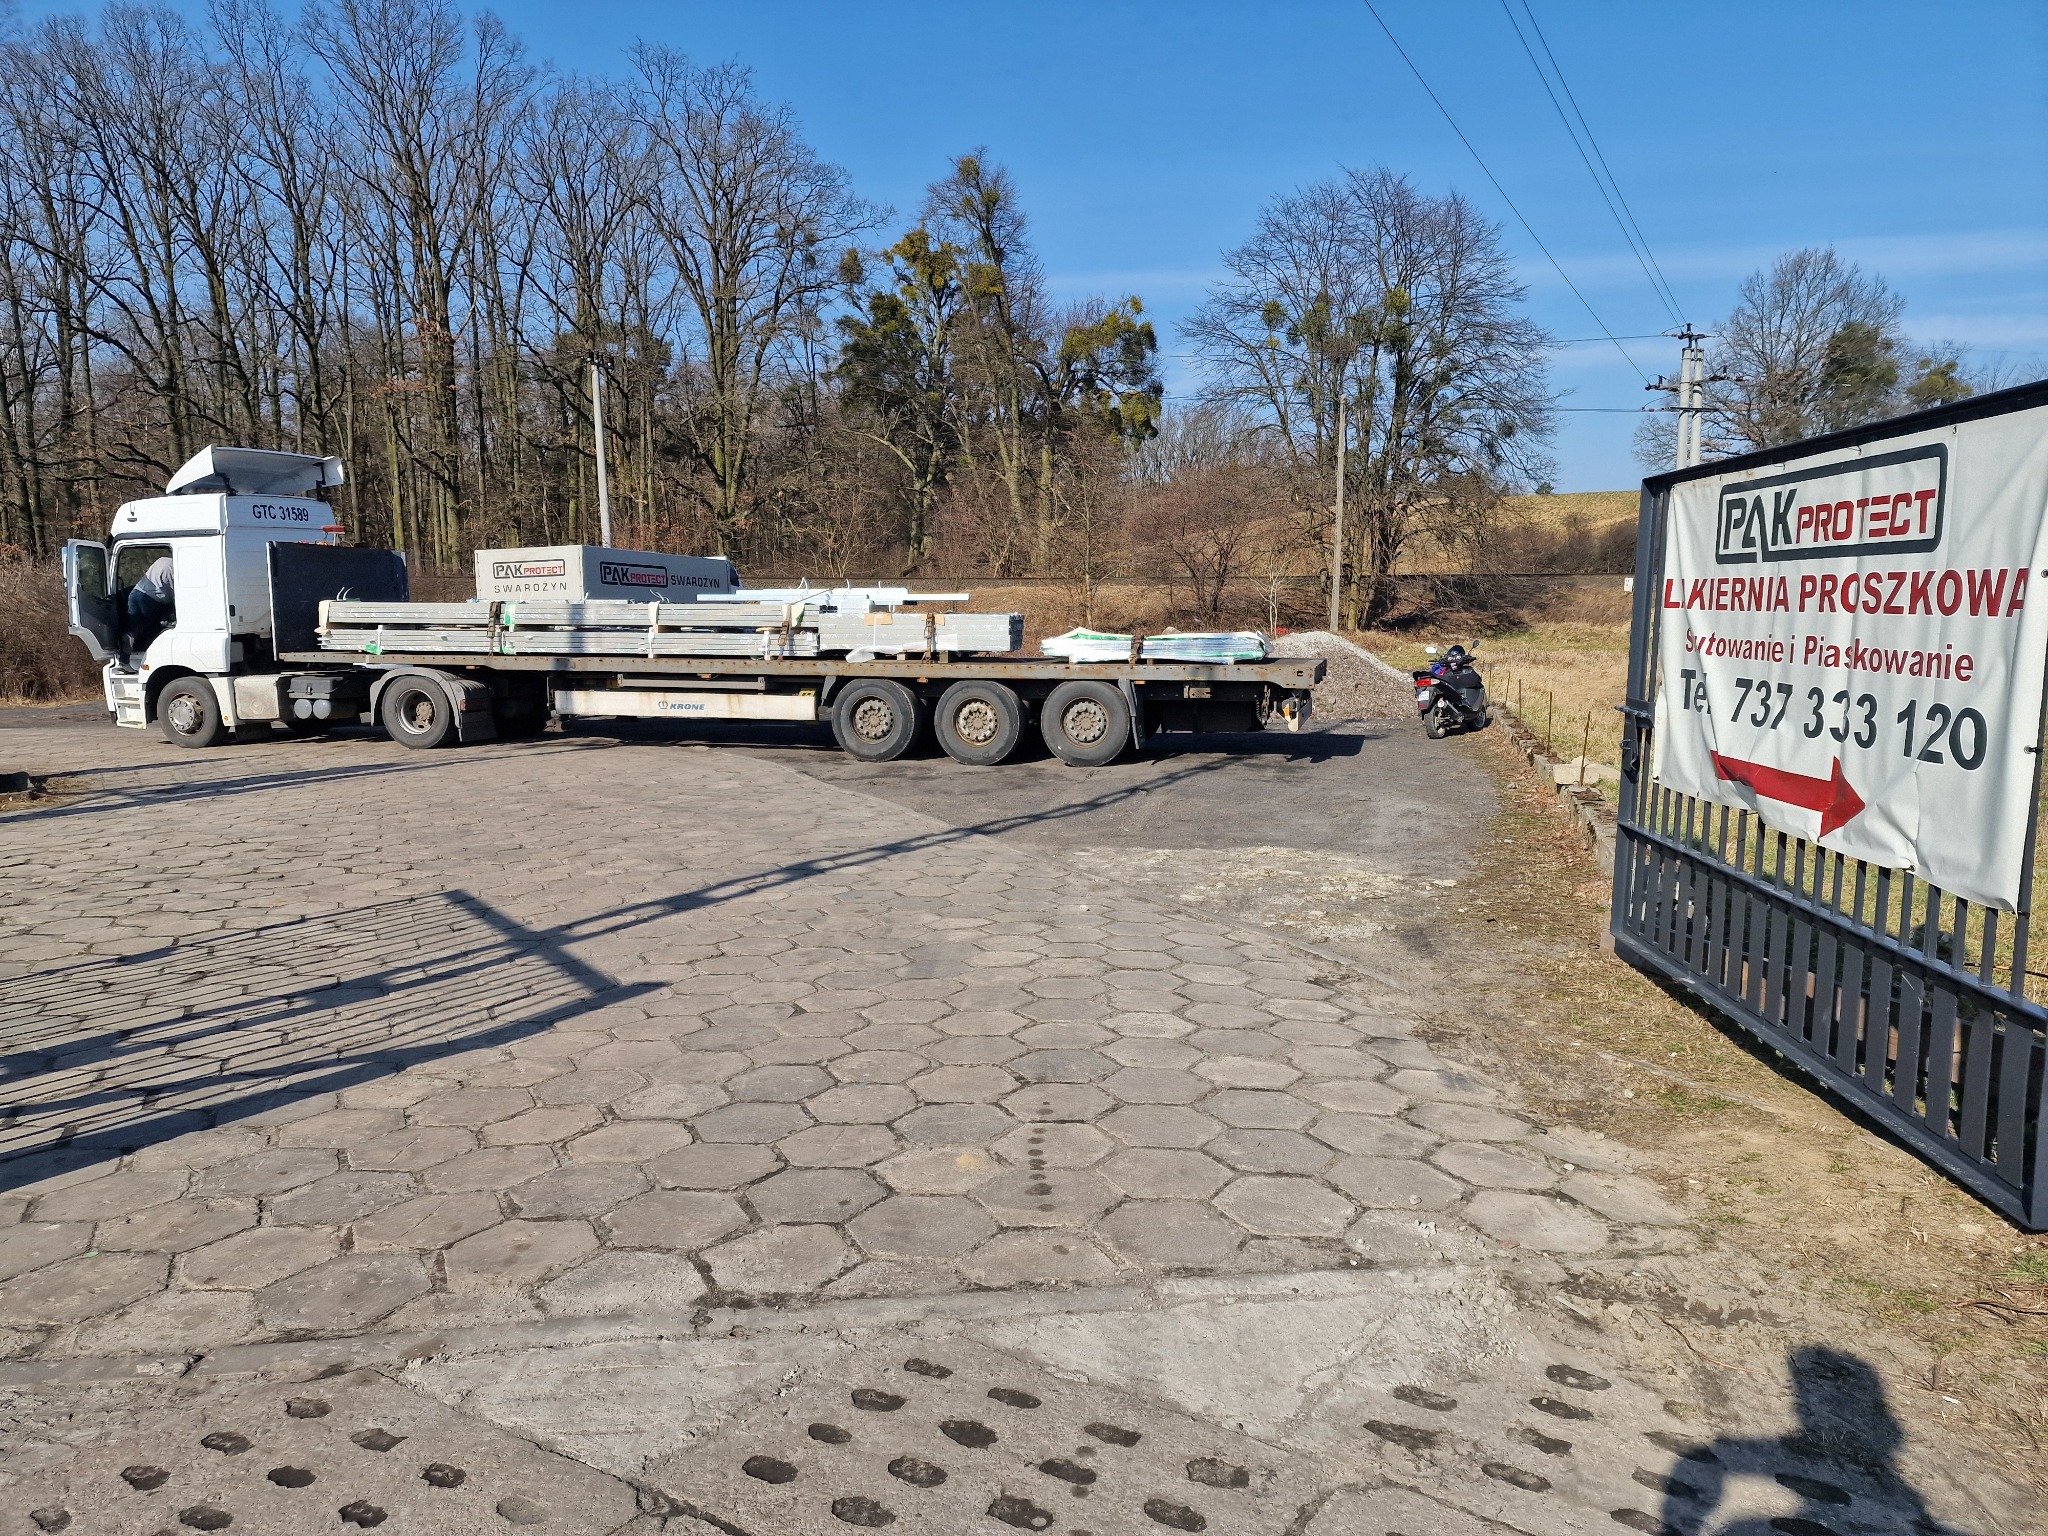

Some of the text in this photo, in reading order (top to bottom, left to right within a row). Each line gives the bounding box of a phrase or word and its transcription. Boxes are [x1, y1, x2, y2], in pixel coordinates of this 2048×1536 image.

[252, 504, 309, 522] GTC 31589
[1722, 488, 1937, 557] PAK PROTECT
[495, 564, 522, 578] PAK
[602, 565, 630, 585] PAK
[670, 574, 720, 590] SWAROŻYN
[494, 581, 567, 594] SWAROŻYN
[1663, 567, 2030, 618] LKIERNIA PROSZKOWA
[1789, 634, 1796, 664] i
[1803, 634, 1974, 682] Piaskowanie
[669, 703, 706, 711] KRONE
[1730, 677, 1794, 730] 737
[1803, 686, 1878, 749] 333
[1896, 699, 1988, 771] 120
